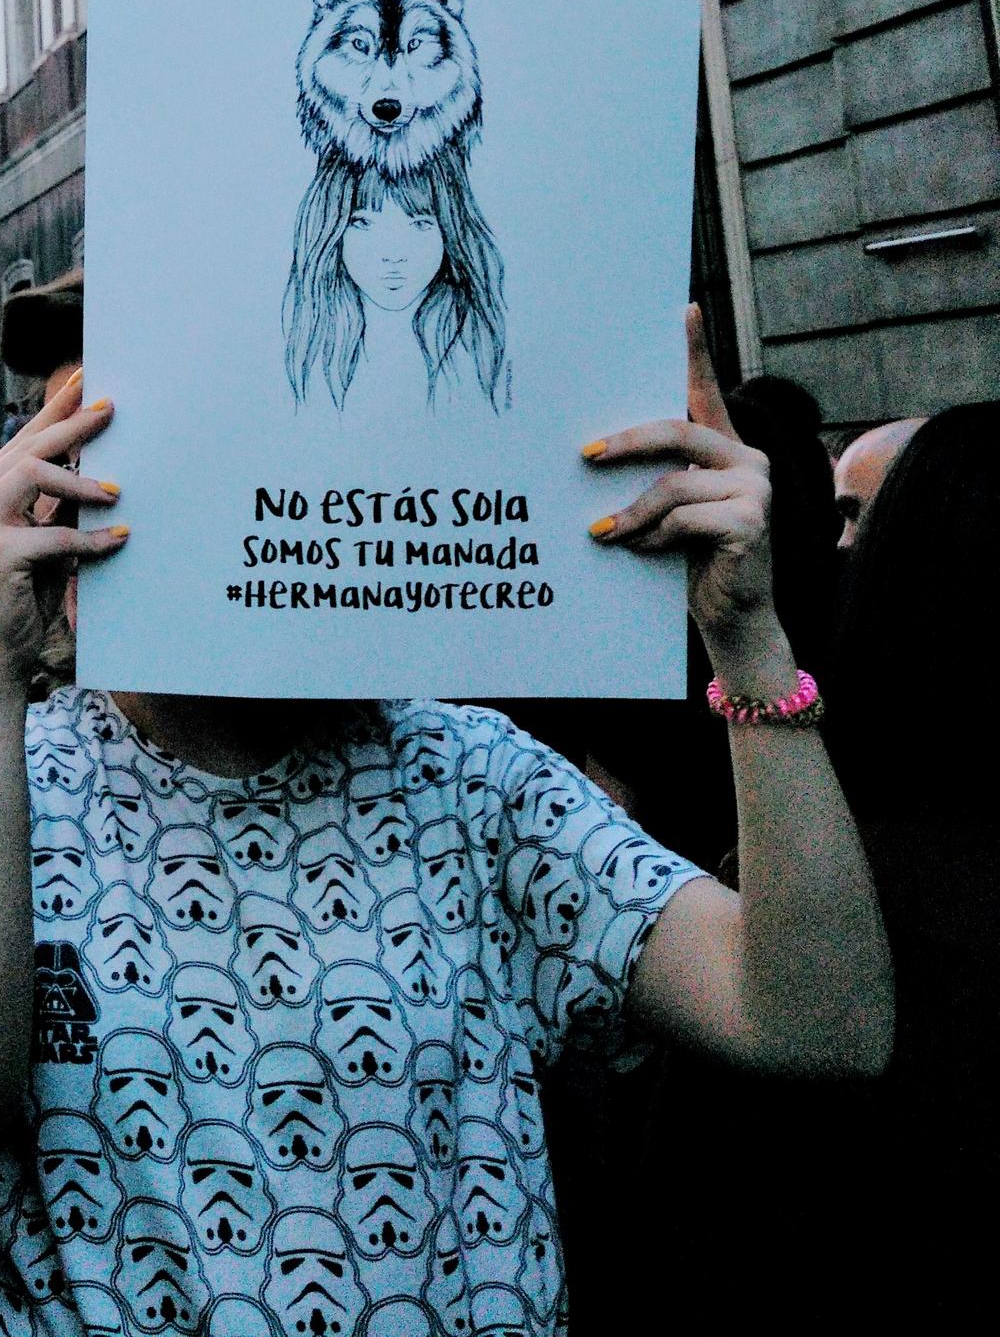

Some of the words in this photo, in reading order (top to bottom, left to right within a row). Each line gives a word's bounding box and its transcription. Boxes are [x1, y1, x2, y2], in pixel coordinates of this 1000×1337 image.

[243, 534, 342, 570] SOMOS
[353, 539, 394, 568] TU
[34, 1023, 98, 1045] TAR
